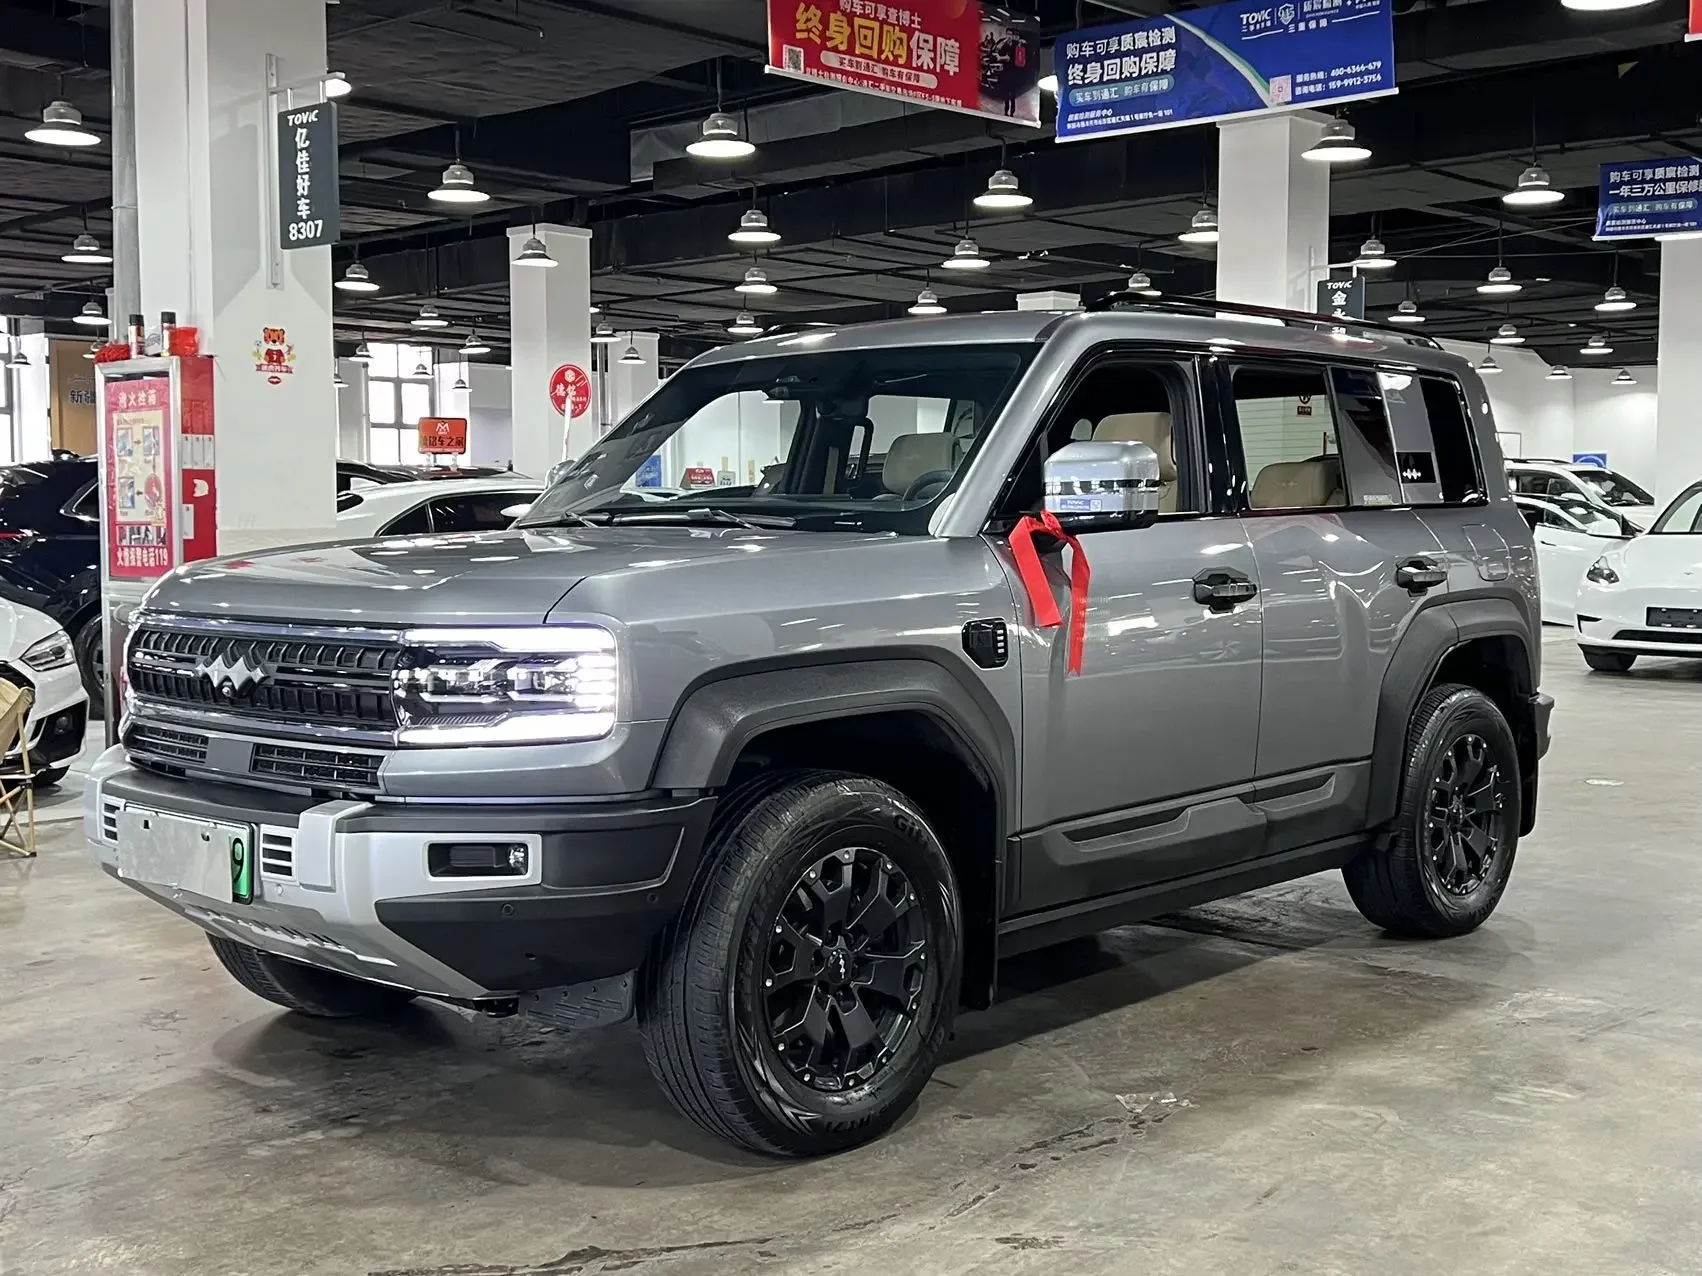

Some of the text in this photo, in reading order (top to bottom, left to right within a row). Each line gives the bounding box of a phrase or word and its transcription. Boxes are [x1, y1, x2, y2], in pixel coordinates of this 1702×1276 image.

[795, 2, 960, 76] 终身回购保障
[1067, 48, 1177, 85] 终身回购保障
[289, 219, 324, 241] 8307
